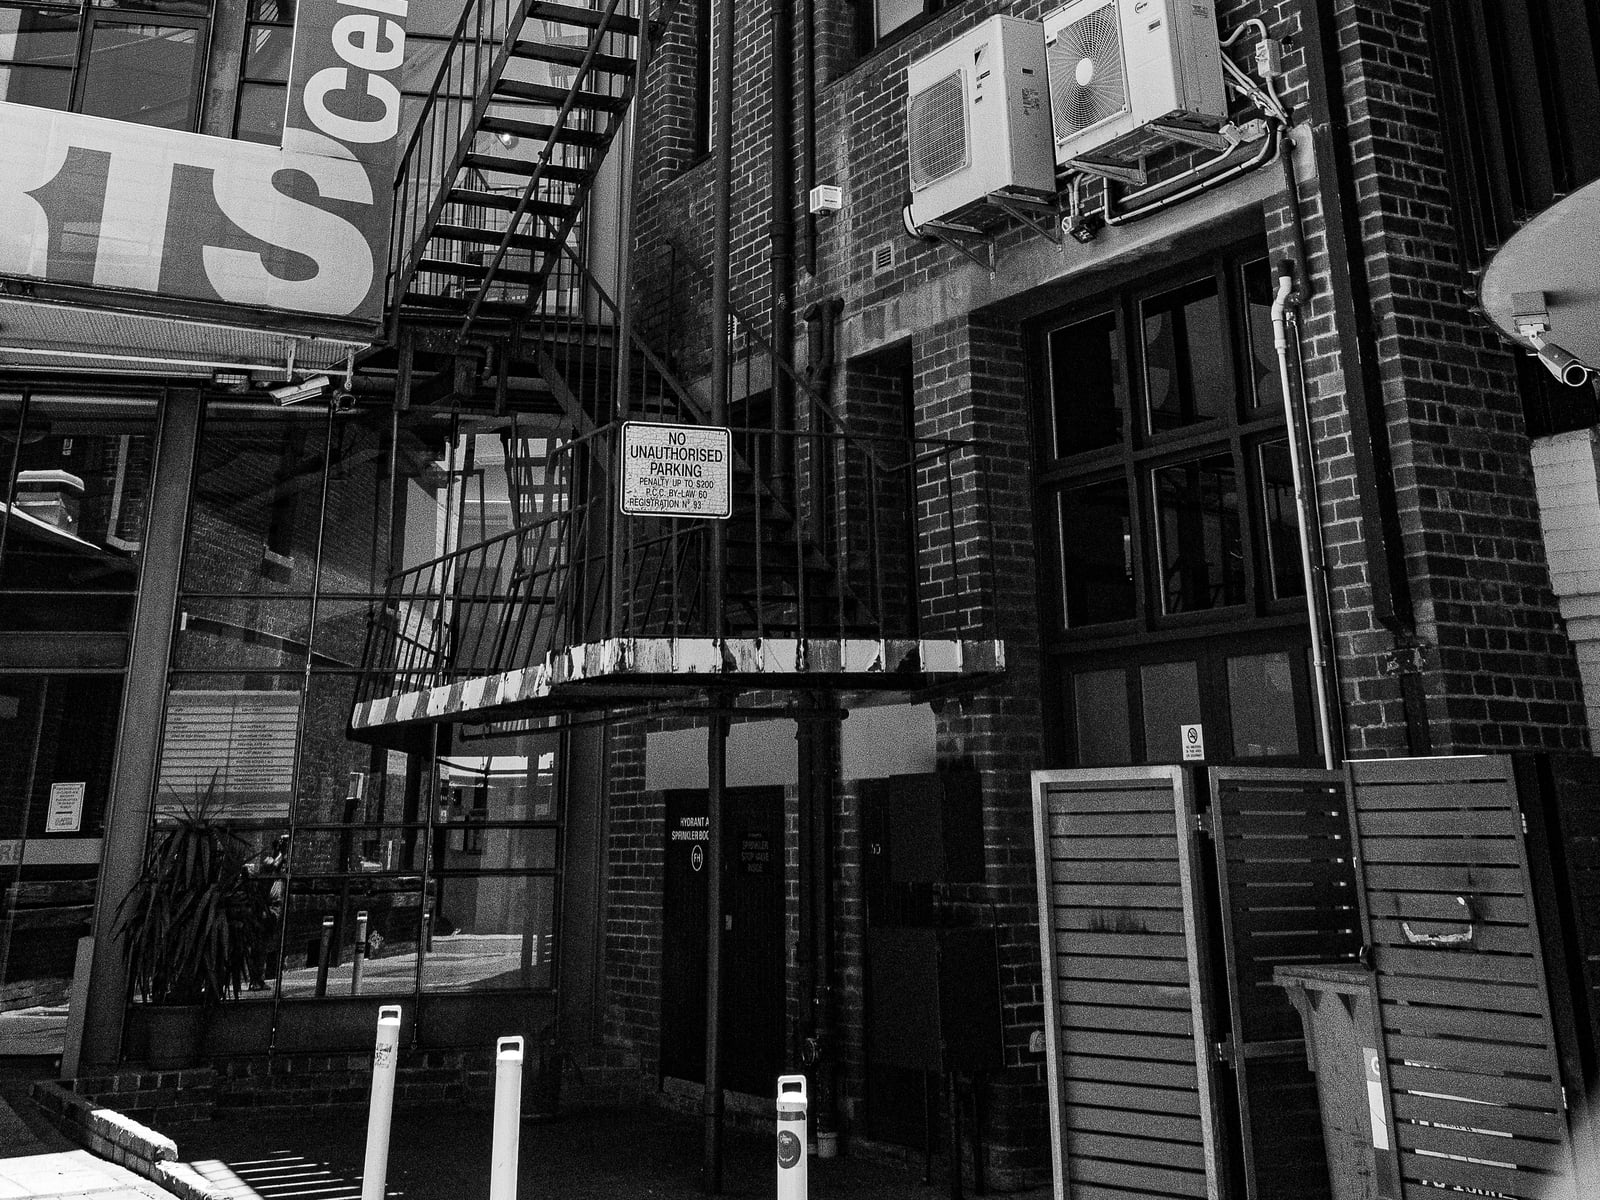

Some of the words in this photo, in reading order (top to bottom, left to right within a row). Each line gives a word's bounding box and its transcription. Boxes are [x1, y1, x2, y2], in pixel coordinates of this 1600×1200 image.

[668, 432, 686, 446] NO
[630, 445, 723, 463] UNAUTHORISED
[650, 462, 702, 478] PARKING
[639, 477, 670, 486] PENALTY
[672, 479, 682, 487] UP
[685, 479, 694, 488] TO
[668, 489, 696, 498] BY-LAW
[629, 498, 680, 509] REGISTRATION
